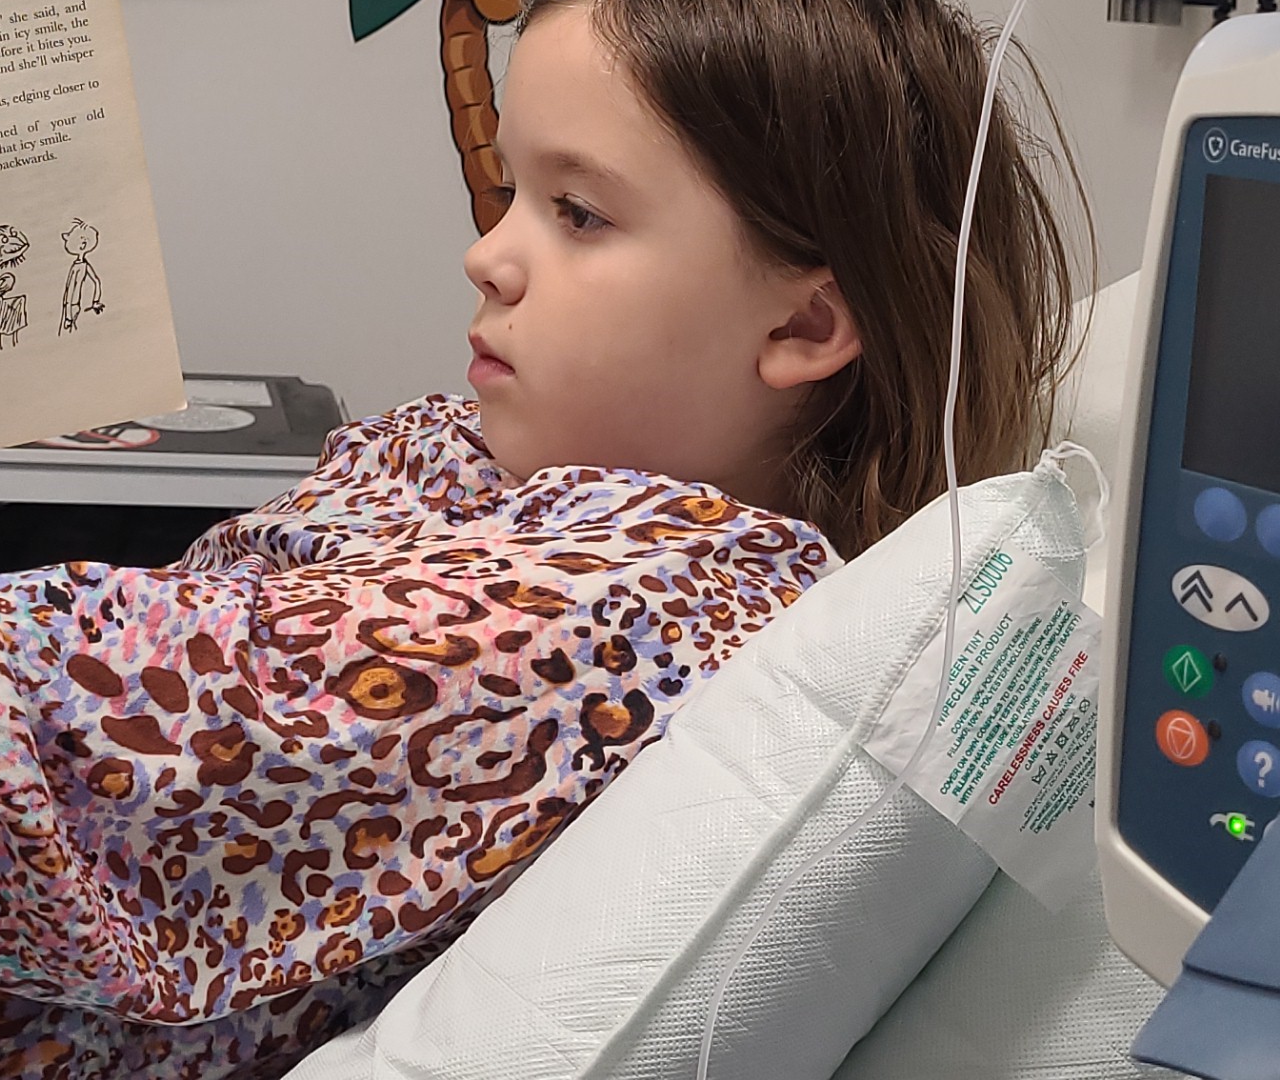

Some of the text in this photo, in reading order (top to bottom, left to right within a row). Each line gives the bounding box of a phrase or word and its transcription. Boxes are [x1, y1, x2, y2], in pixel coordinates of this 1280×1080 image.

[8, 10, 28, 24] she
[32, 4, 59, 20] said,
[64, 0, 86, 14] and
[14, 26, 31, 42] icy
[33, 19, 67, 36] smile,
[70, 15, 89, 28] the
[17, 54, 47, 70] she'll
[49, 46, 96, 67] whisper
[25, 41, 35, 52] it
[37, 35, 64, 50] bites
[66, 33, 92, 48] you.
[11, 86, 51, 106] edging
[51, 80, 85, 95] closer
[87, 78, 100, 88] to
[26, 120, 40, 132] of
[50, 116, 78, 131] your
[85, 107, 105, 120] old
[19, 137, 37, 152] icy
[38, 130, 71, 146] smile.
[956, 545, 1014, 615] ZLS0006
[963, 629, 985, 655] TINT
[974, 612, 1014, 666] PRODUCT
[968, 687, 985, 707] 100%
[971, 741, 989, 764] HAVE
[984, 722, 1001, 743] BEEN
[997, 694, 1020, 723] TESTED
[1015, 682, 1026, 695] TO
[1021, 654, 1044, 684] ENSURE
[1040, 609, 1073, 655] COMPLIANCE
[977, 665, 1010, 710] POLYESTER
[958, 784, 975, 805] WITH
[970, 769, 984, 785] THE
[979, 728, 1010, 771] FURNITURE
[1005, 712, 1020, 730] AND
[1014, 666, 1049, 714] FURNISHINGS
[985, 650, 1089, 805] CARELESSNESS CAUSES FIRE
[1004, 697, 1042, 749] REGULATIONS
[1023, 748, 1040, 771] CARE
[1040, 692, 1077, 744] MAINTENANCE
[939, 767, 960, 795] COVER
[999, 689, 1011, 703] TO
